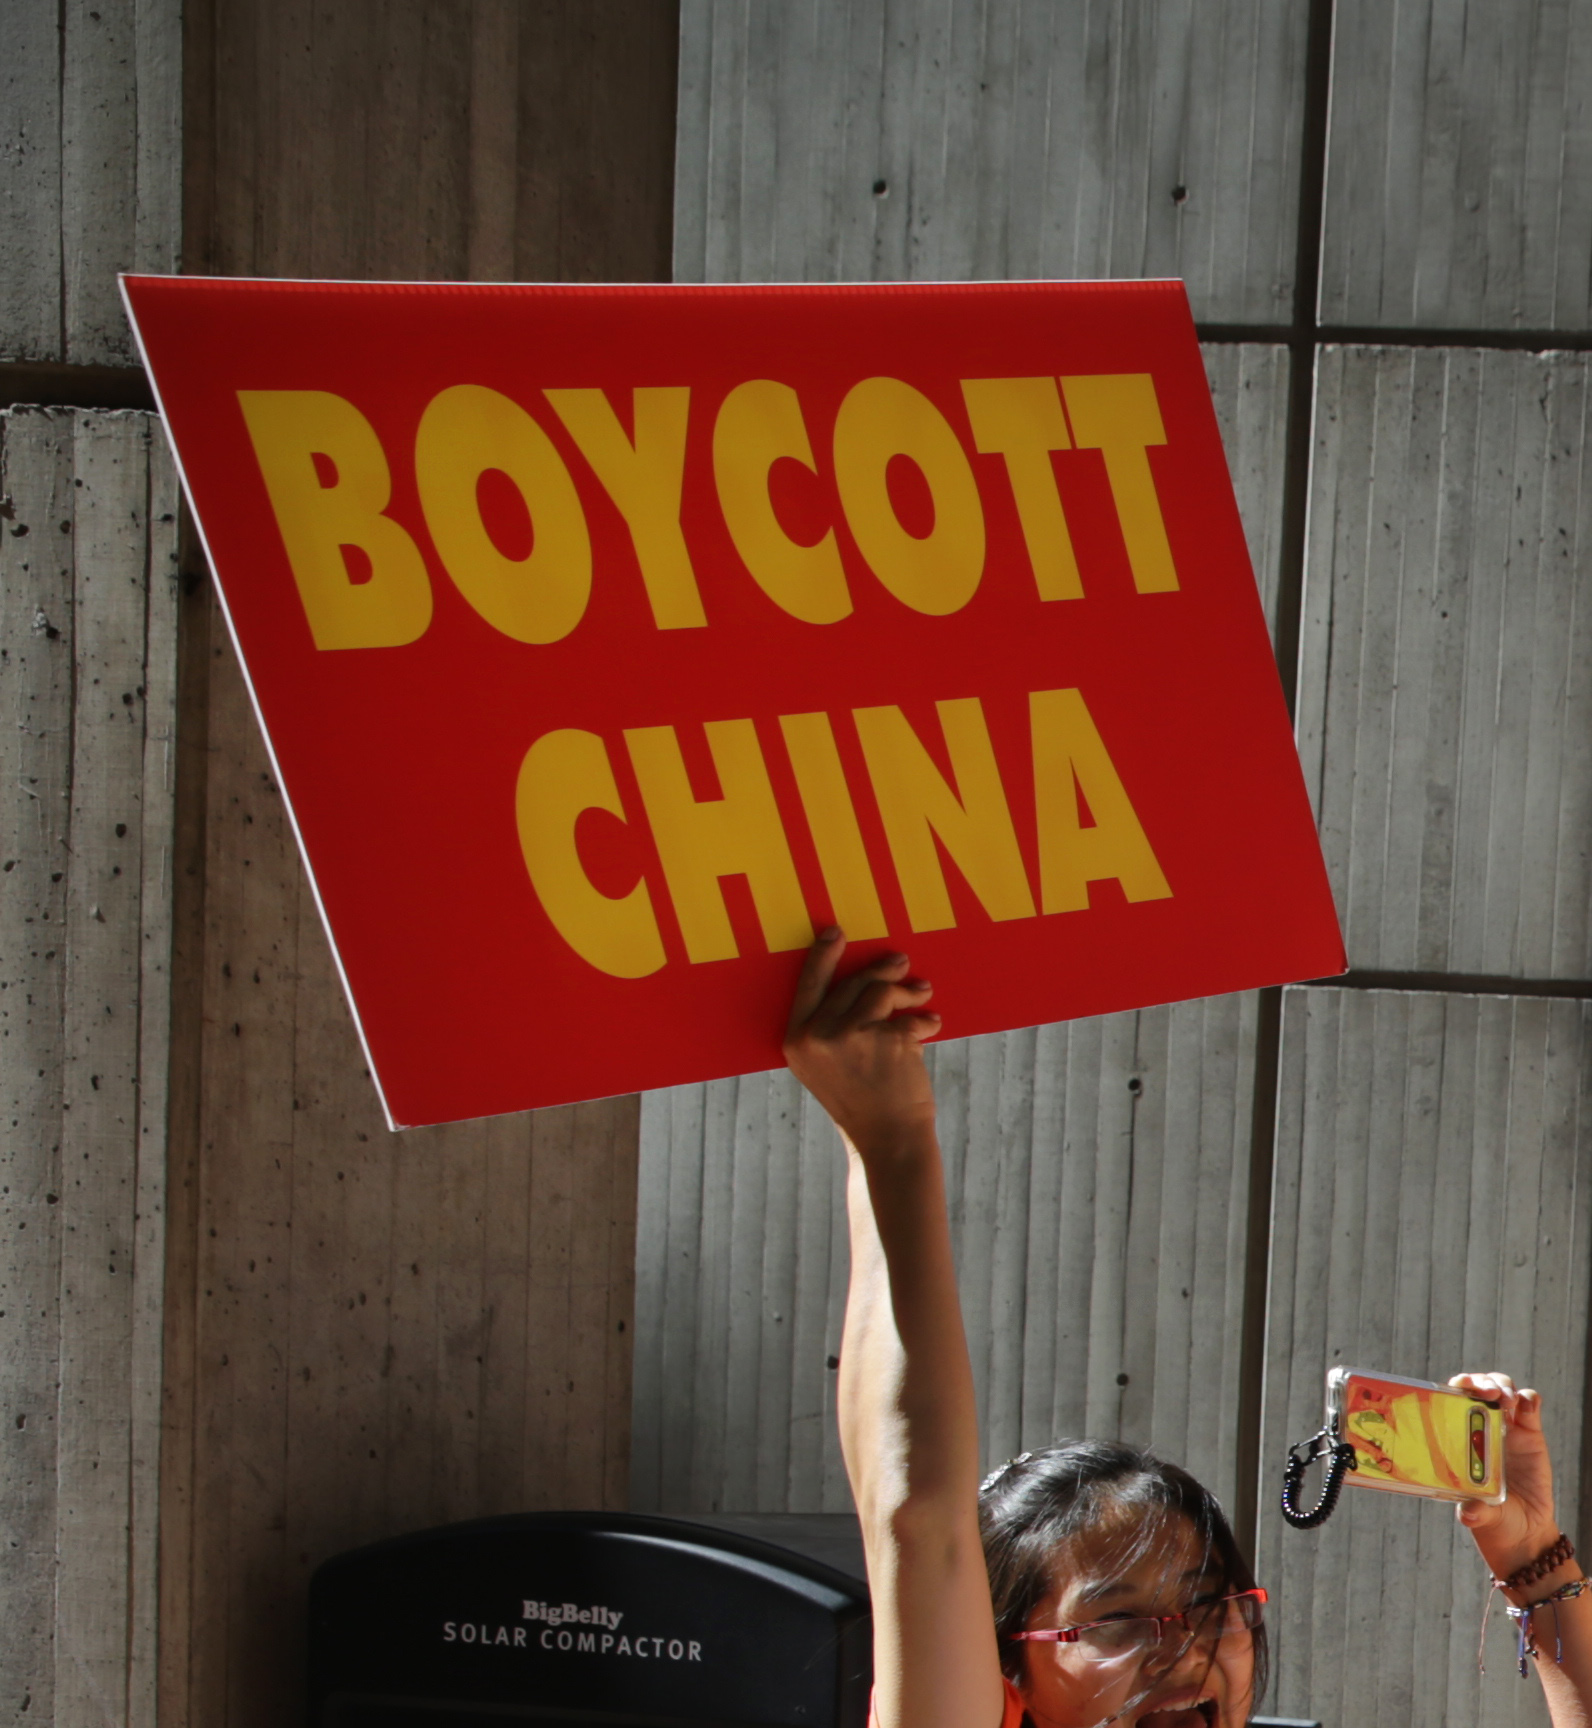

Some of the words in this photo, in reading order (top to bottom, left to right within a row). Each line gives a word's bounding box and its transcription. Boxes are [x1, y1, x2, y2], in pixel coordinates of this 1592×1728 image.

[239, 374, 1180, 651] BOYCOTT
[515, 687, 1173, 979] CHINA
[443, 1621, 527, 1648] SOLAR
[540, 1629, 702, 1662] COMPACTOR
[522, 1600, 624, 1630] BigBelly
